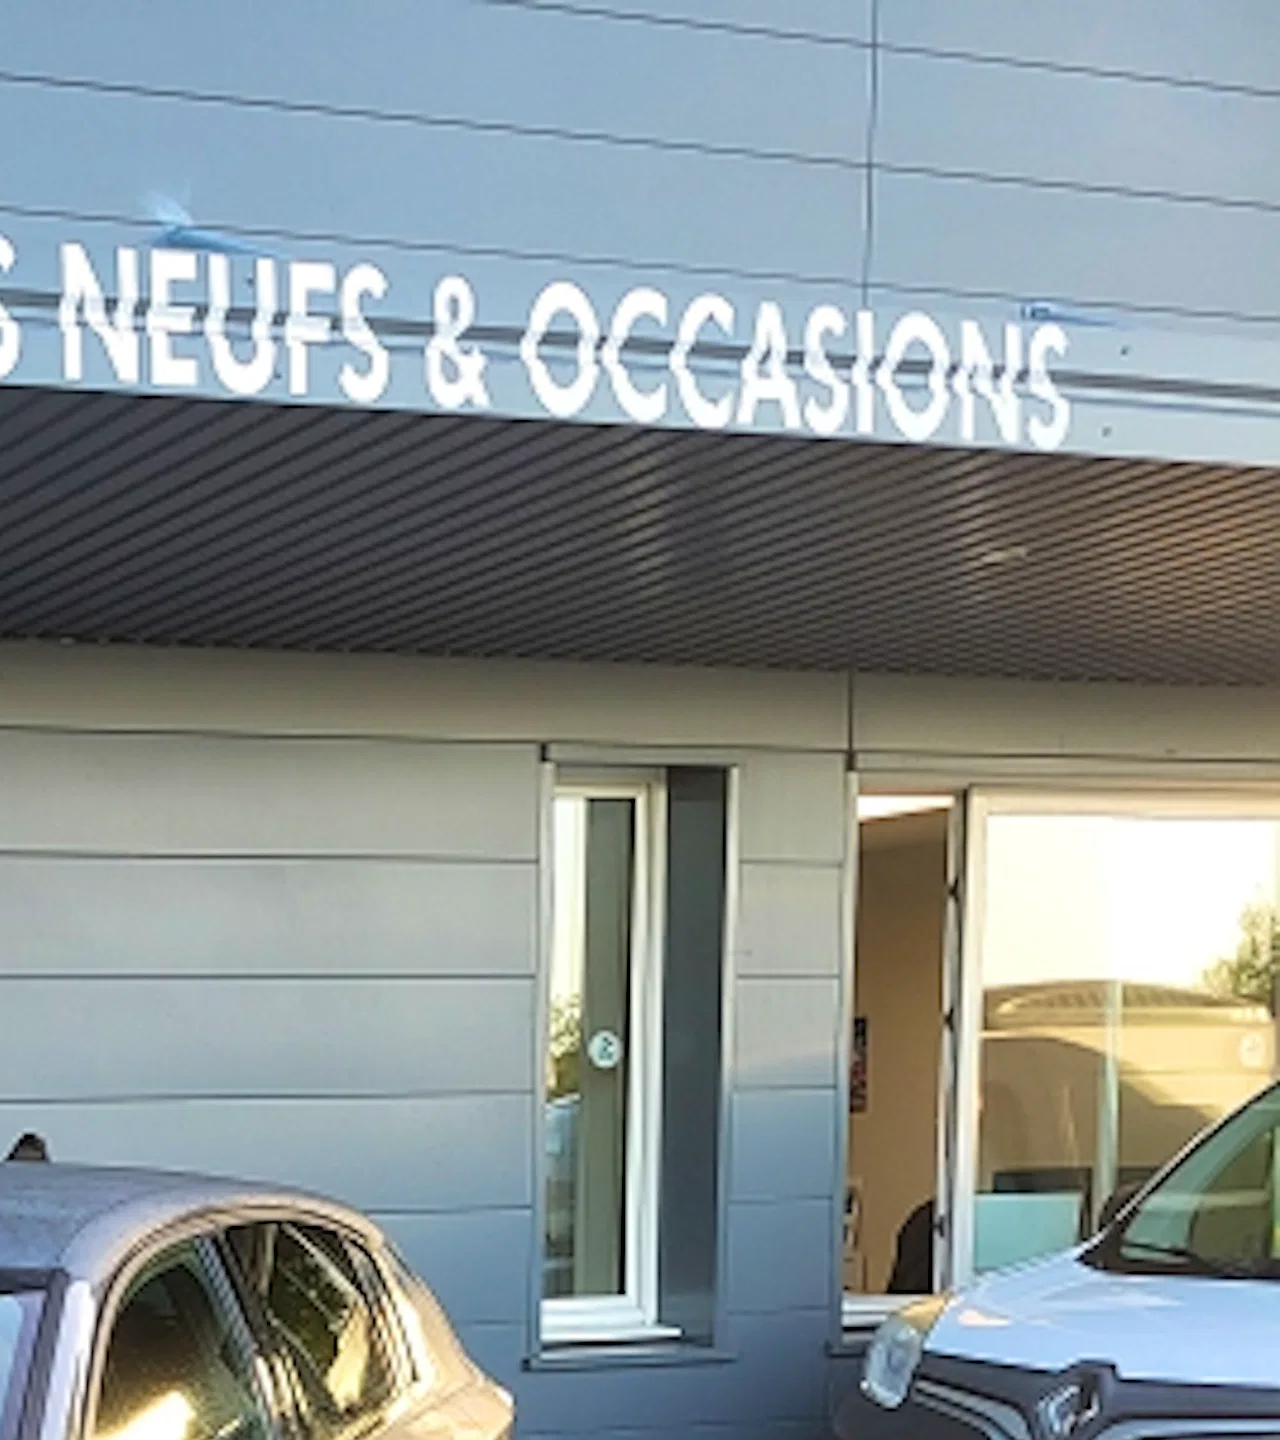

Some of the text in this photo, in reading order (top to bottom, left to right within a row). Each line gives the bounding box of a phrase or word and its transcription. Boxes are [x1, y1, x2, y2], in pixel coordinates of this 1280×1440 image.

[59, 241, 391, 404] NEUFS
[425, 274, 490, 409] &
[520, 280, 1072, 452] OCCASIONS
